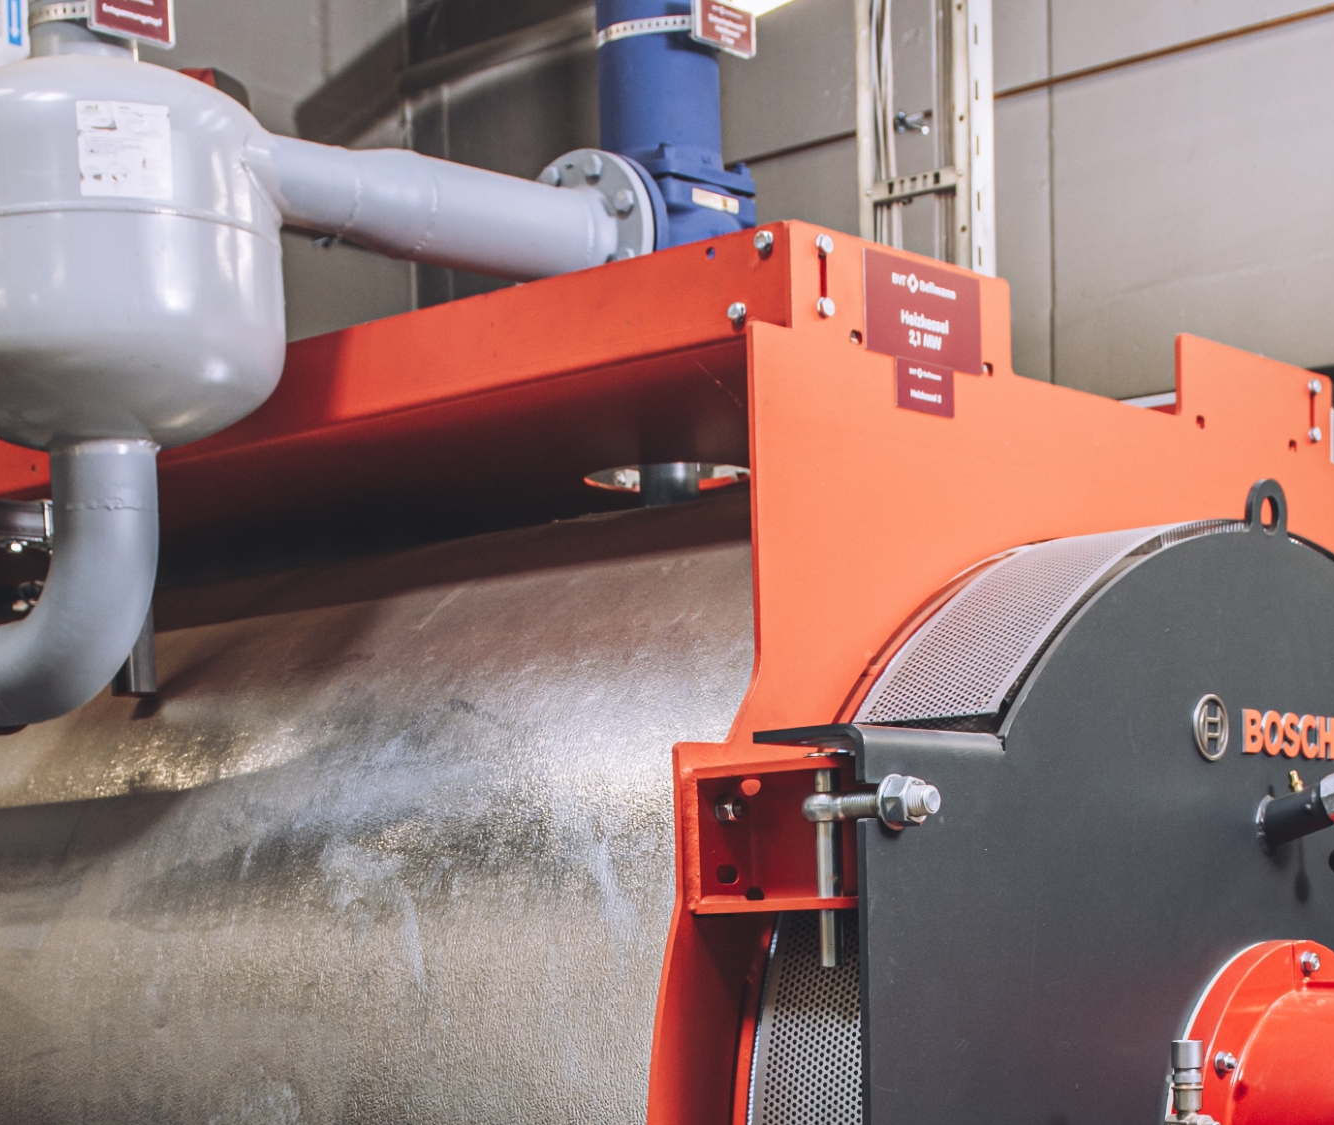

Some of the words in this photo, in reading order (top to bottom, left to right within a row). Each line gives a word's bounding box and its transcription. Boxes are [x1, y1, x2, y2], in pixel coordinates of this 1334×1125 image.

[900, 308, 950, 335] Heizkessel
[908, 329, 921, 347] 2,1
[923, 332, 942, 351] MW
